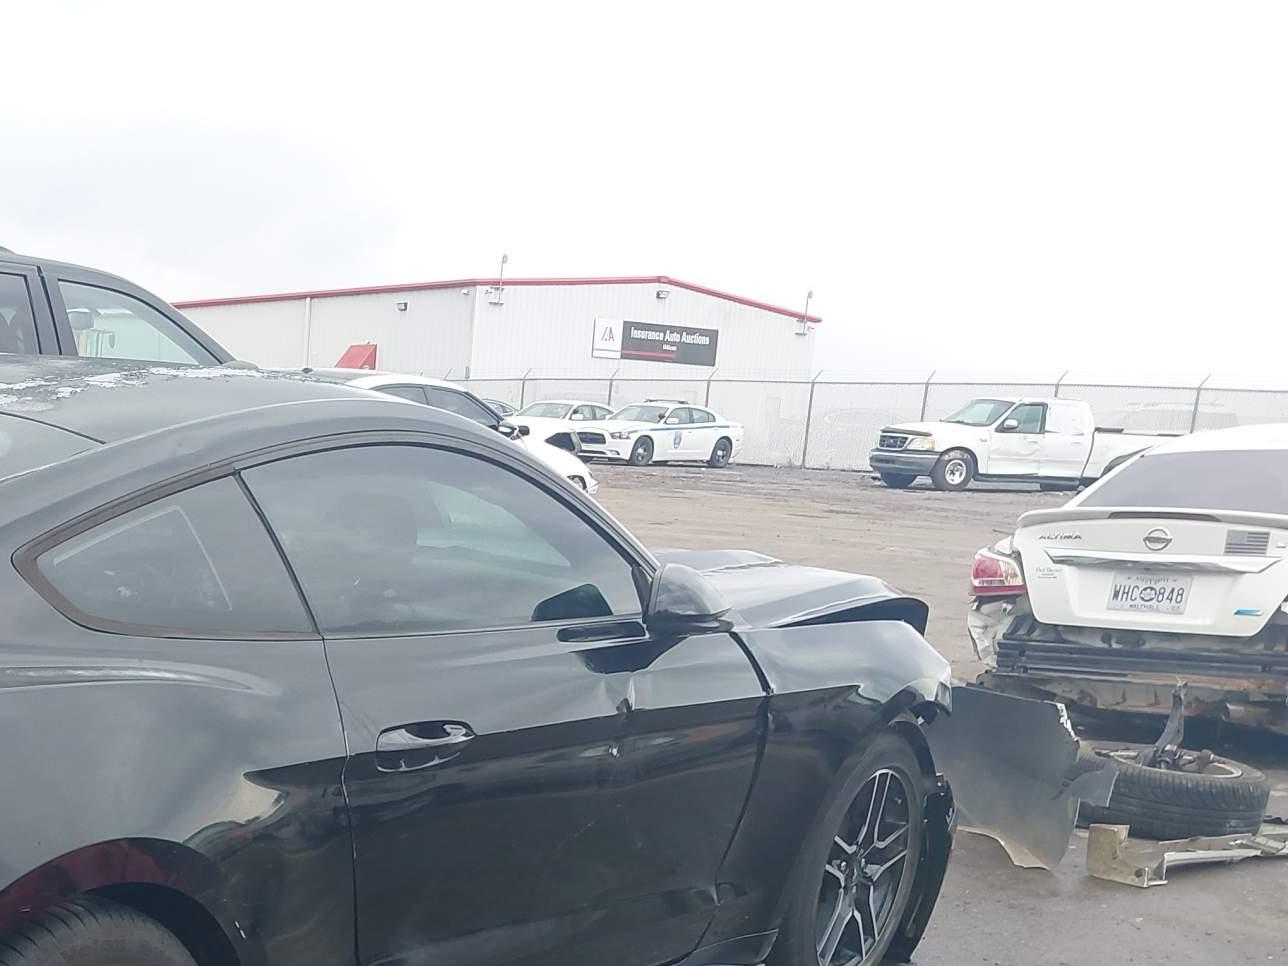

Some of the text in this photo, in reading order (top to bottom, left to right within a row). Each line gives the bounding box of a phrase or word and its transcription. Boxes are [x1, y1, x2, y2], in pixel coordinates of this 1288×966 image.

[630, 326, 710, 345] Insurance Auto Auctions
[1112, 584, 1185, 604] WHC 848
